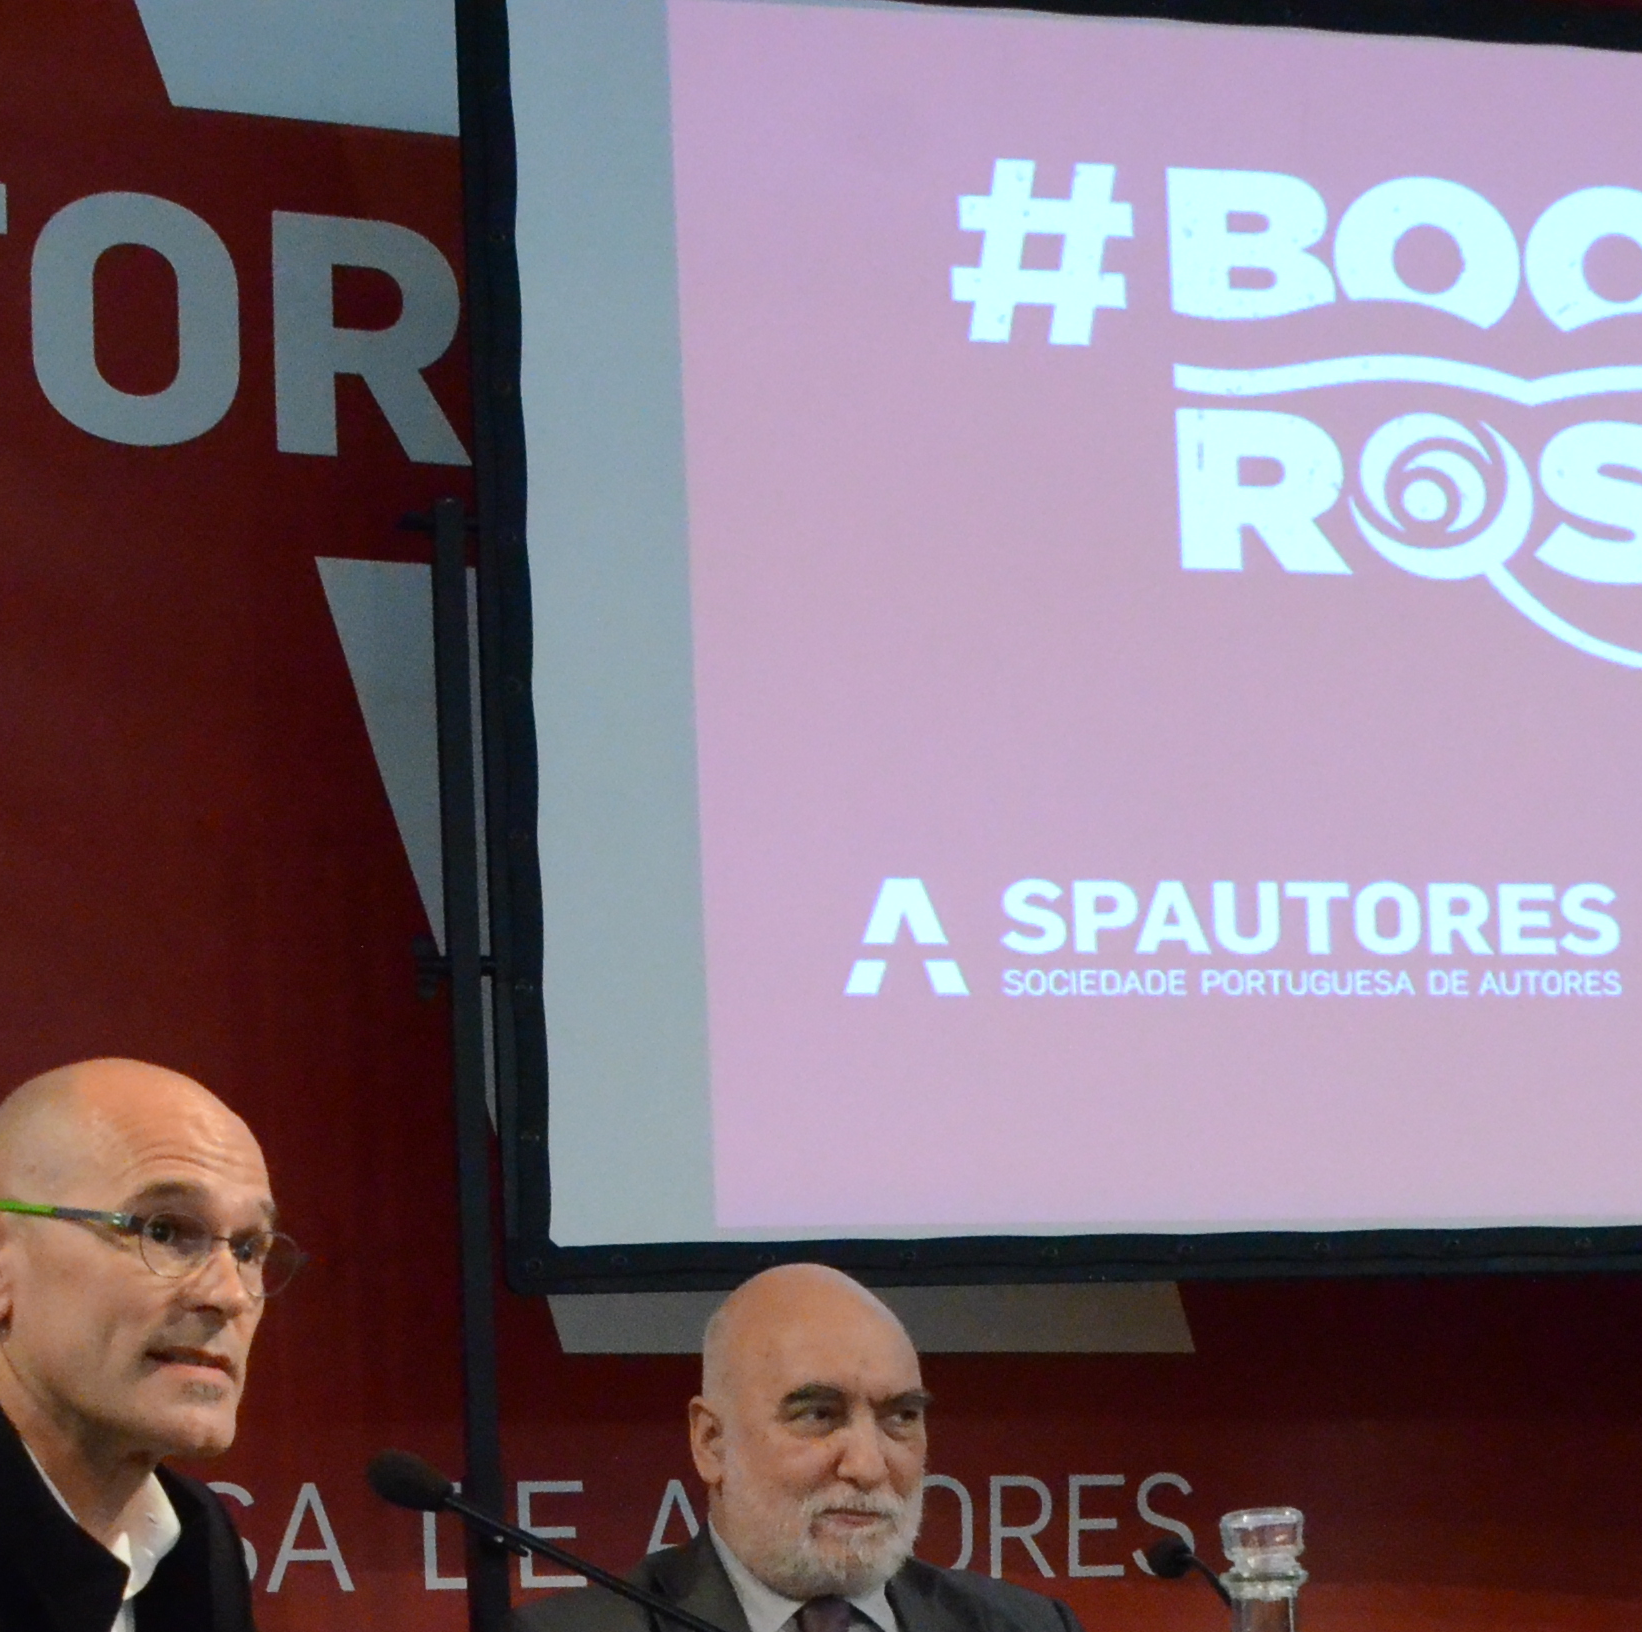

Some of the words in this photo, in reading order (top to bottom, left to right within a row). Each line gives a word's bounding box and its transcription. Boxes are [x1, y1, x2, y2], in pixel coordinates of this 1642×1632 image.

[1001, 878, 1622, 957] SPAUTORES
[1003, 969, 1187, 996] SOCIEDADE
[1200, 969, 1415, 997] PORTUGUESA
[1428, 969, 1469, 997] DE
[1479, 969, 1622, 997] AUTORES
